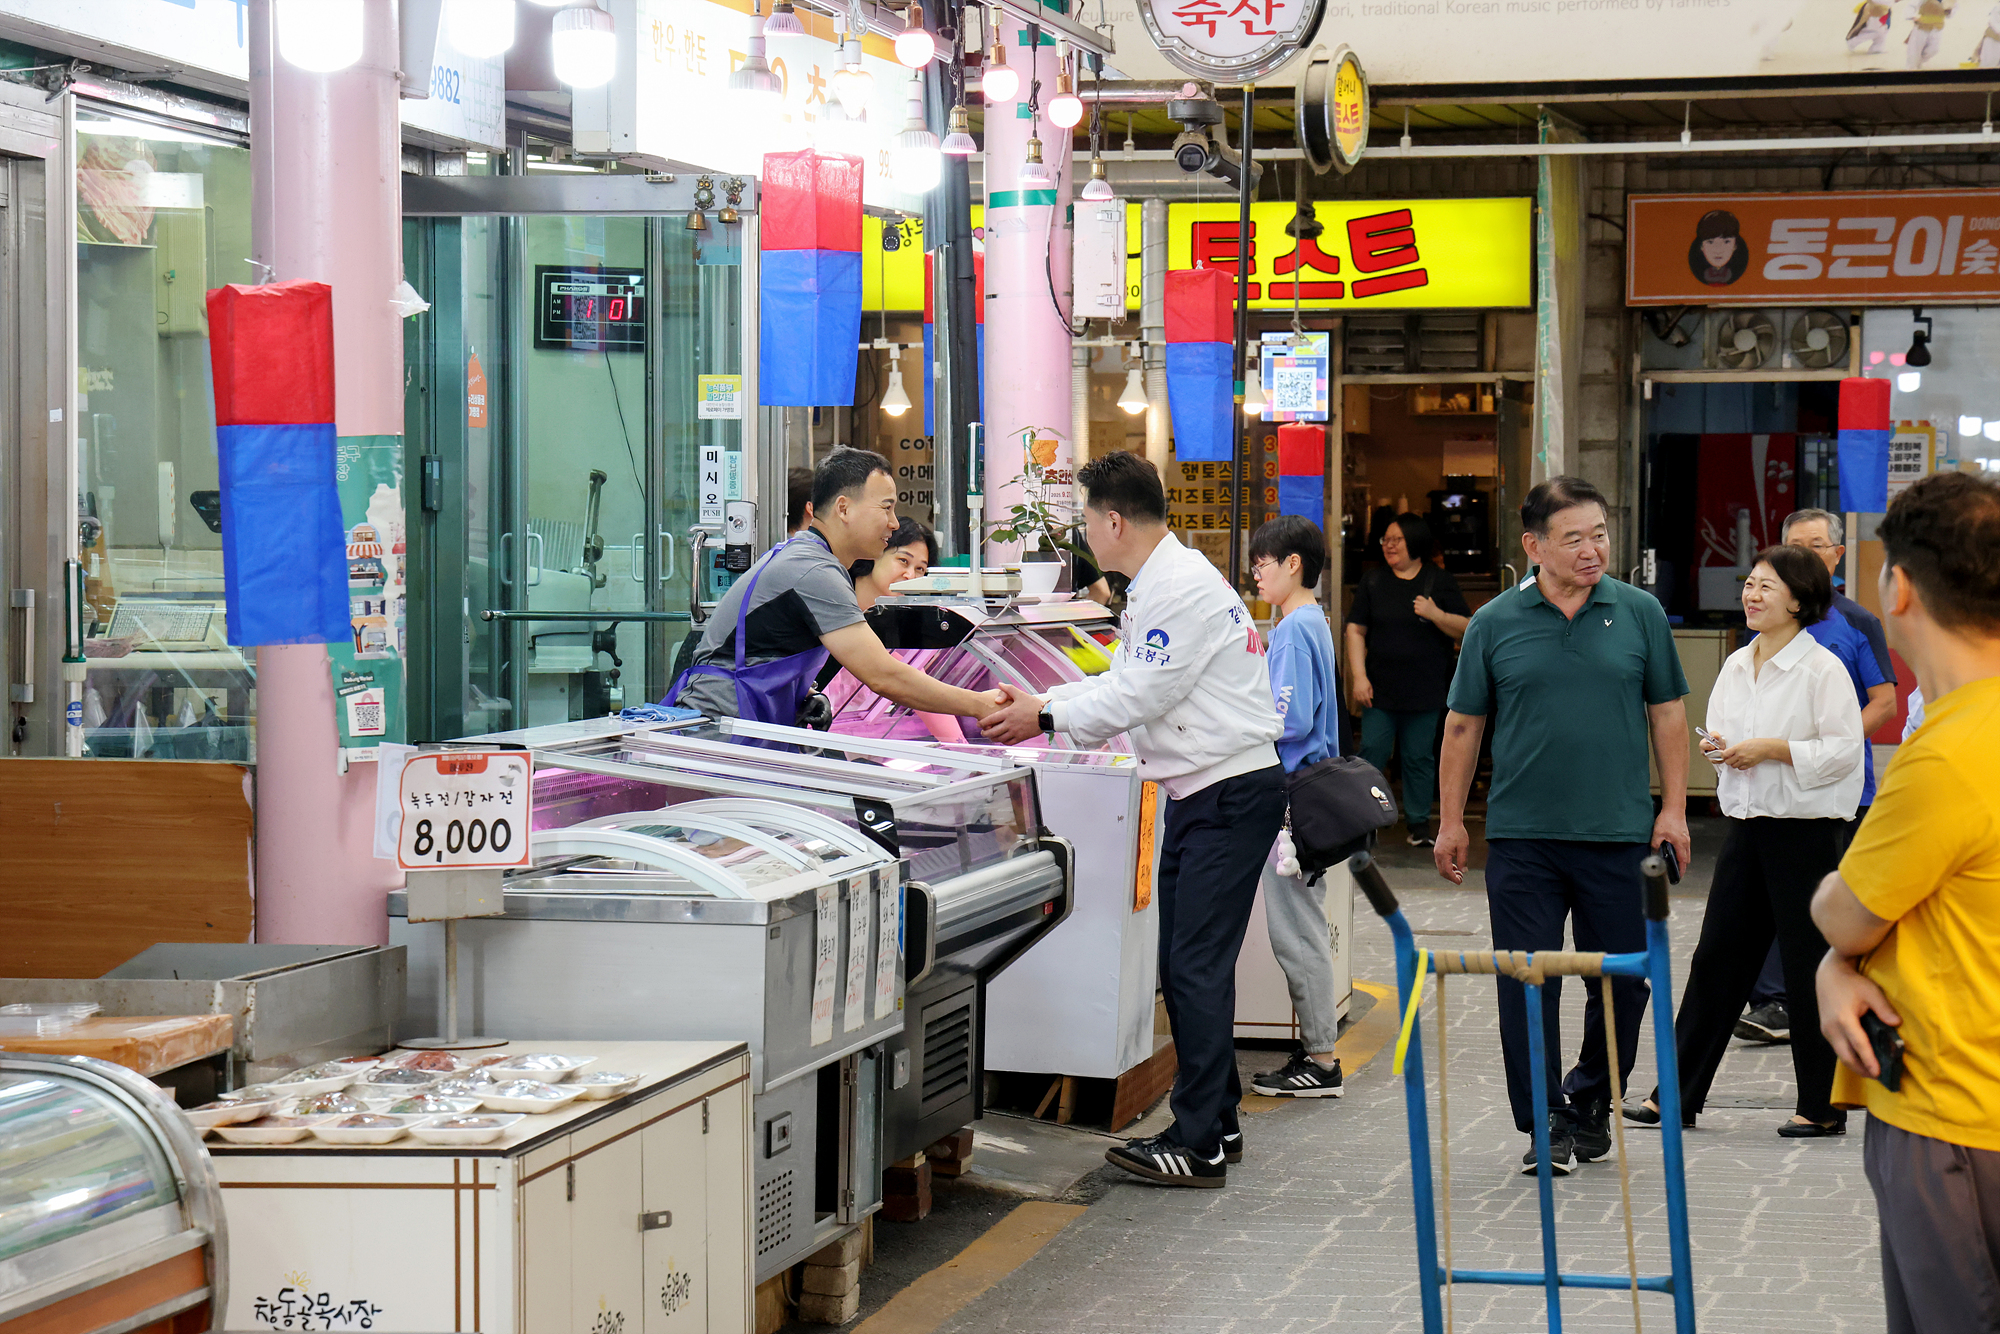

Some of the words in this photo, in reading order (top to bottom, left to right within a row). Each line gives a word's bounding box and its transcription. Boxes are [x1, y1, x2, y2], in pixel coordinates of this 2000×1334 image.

[1361, 2, 1439, 17] traditional
[1445, 1, 1500, 14] Korean
[1506, 0, 1550, 13] music
[1191, 208, 1429, 300] 토스트
[1763, 215, 1965, 281] 동근이
[705, 450, 718, 505] 미시오
[702, 509, 721, 517] PUSH
[1134, 647, 1171, 666] 도봉구
[414, 818, 512, 863] 8,000
[253, 1287, 383, 1332] 창동골목시장
